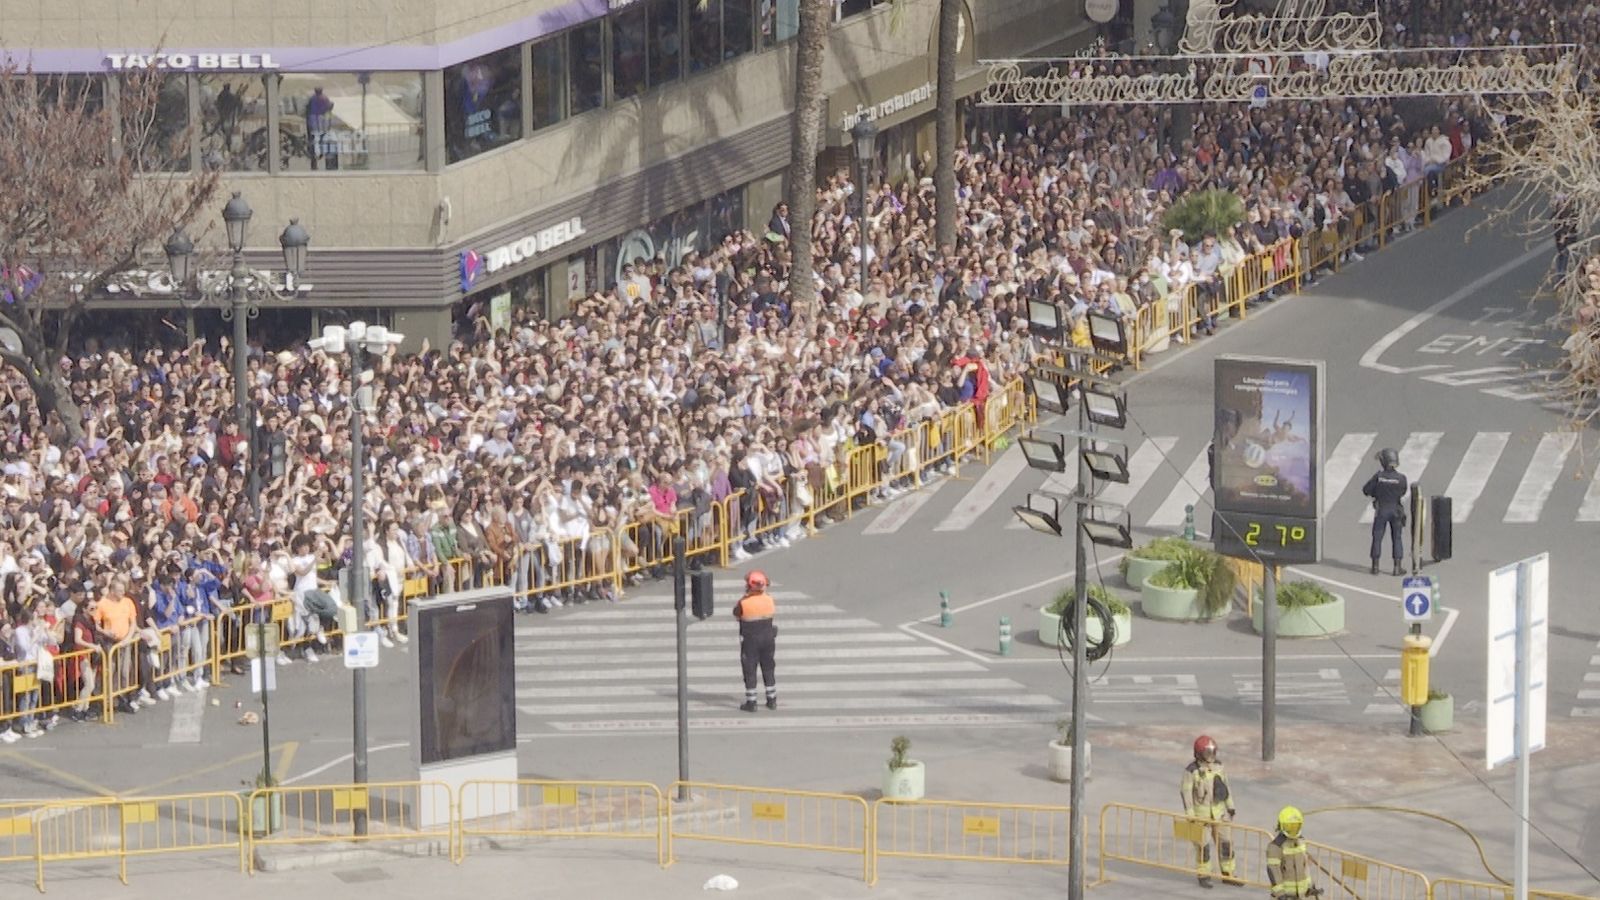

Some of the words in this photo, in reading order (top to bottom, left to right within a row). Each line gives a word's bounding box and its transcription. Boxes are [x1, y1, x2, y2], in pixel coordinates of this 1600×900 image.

[1178, 0, 1382, 54] Falles
[106, 53, 191, 69] TACO
[198, 53, 280, 69] BELL
[980, 61, 1198, 103] Patrimoni
[1204, 56, 1256, 101] de
[1269, 56, 1318, 98] la
[880, 81, 931, 118] restaurant
[485, 234, 536, 272] TACO
[537, 217, 586, 252] BELL
[1416, 334, 1546, 357] EMT
